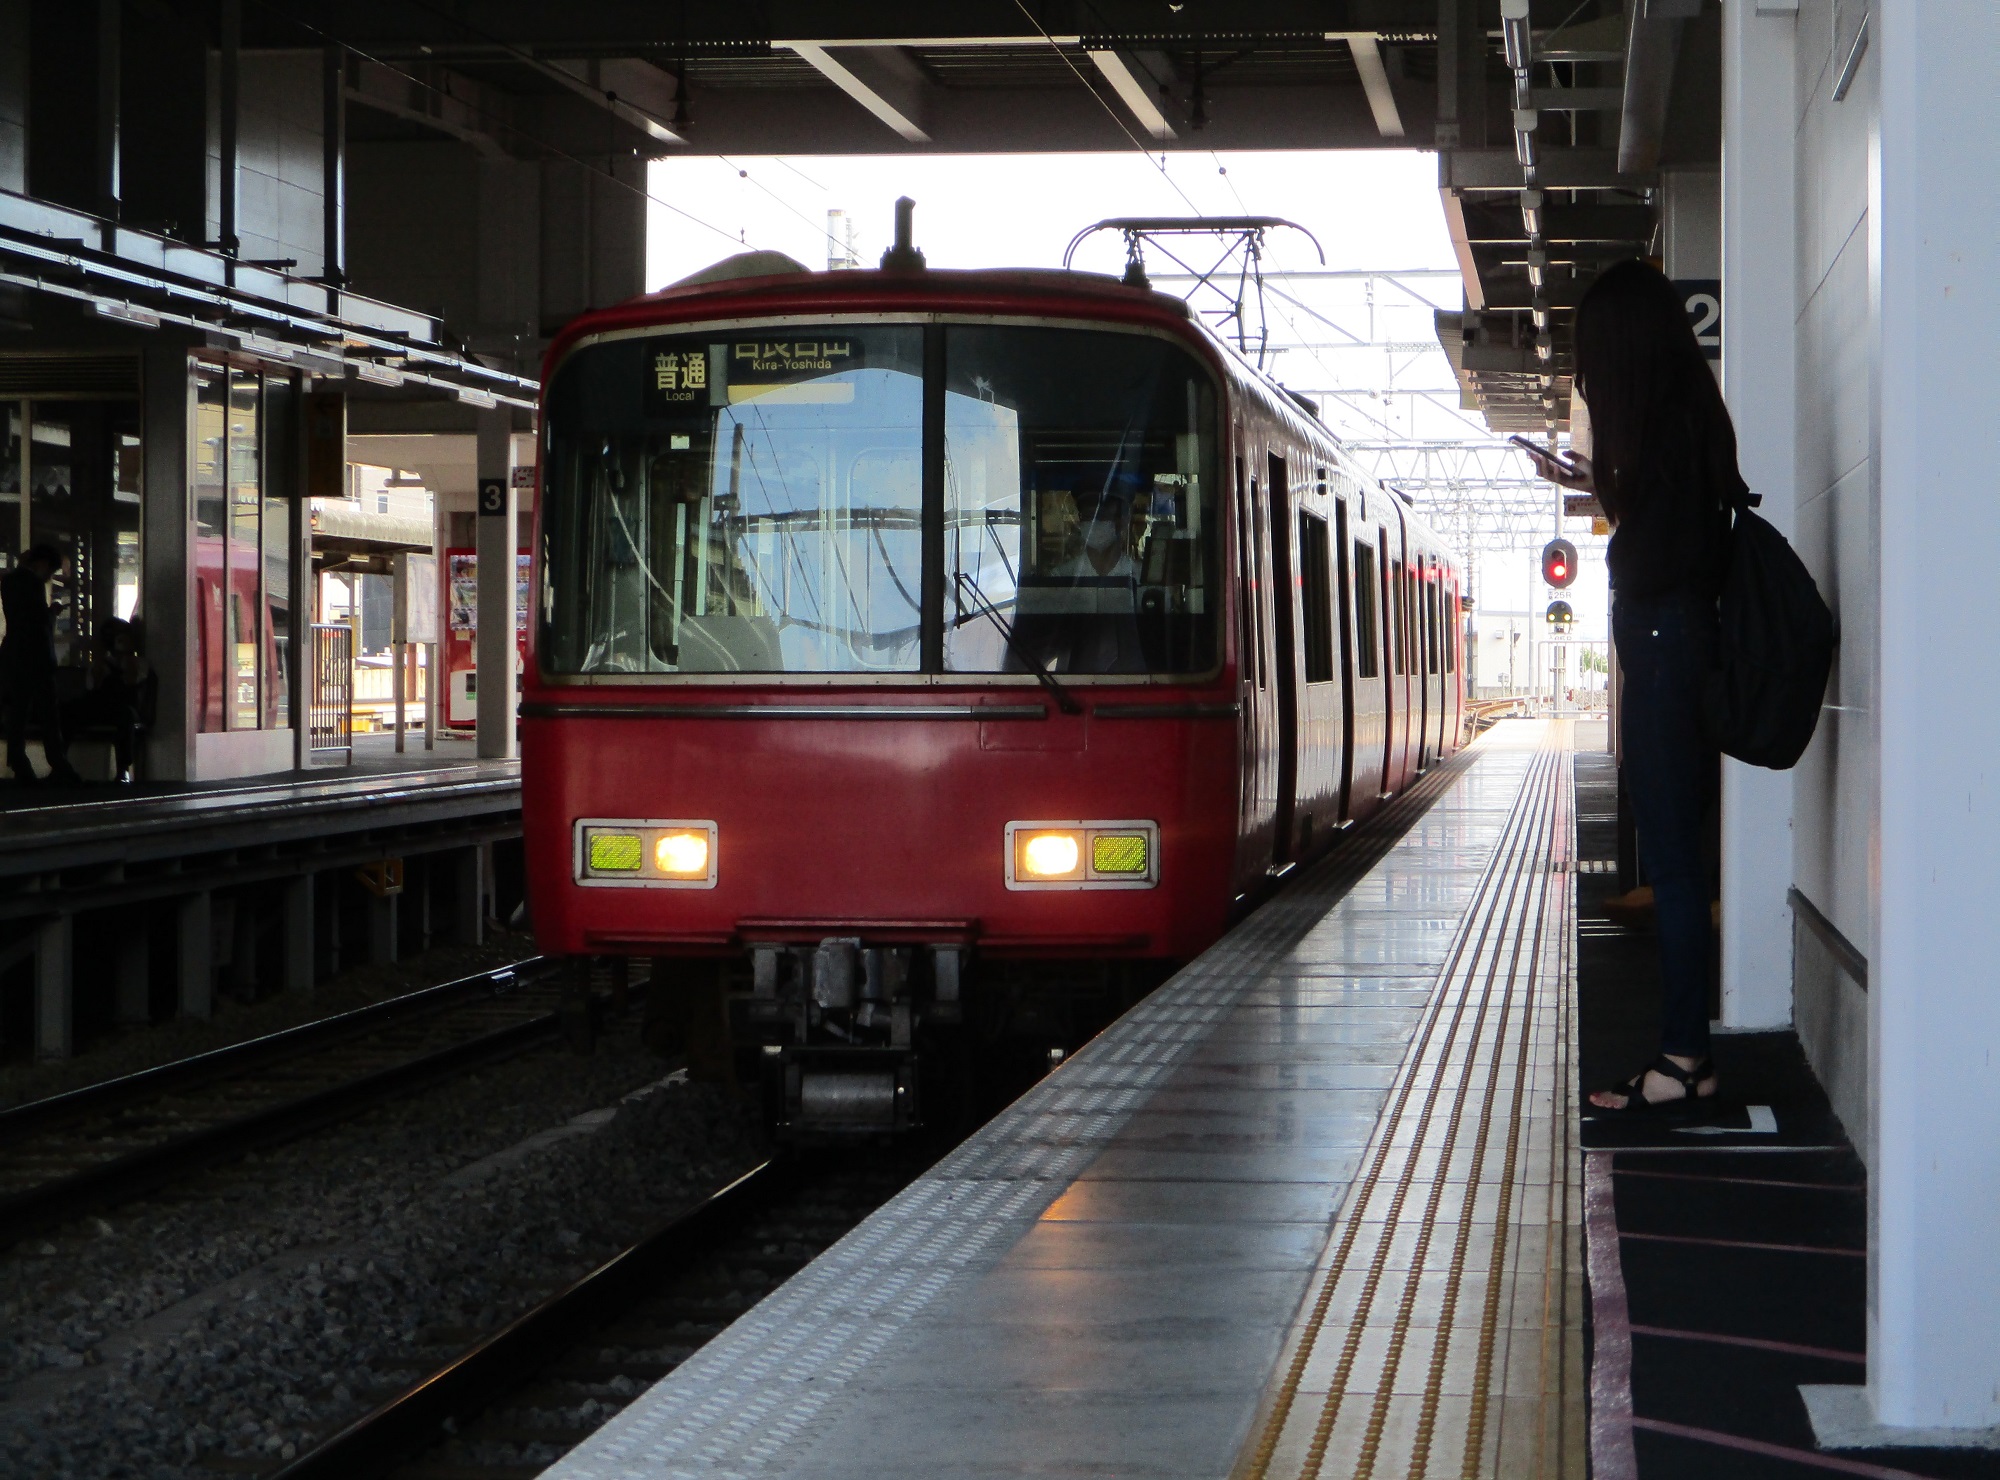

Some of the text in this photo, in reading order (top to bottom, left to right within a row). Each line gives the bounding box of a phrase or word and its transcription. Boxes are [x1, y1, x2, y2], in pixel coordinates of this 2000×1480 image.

[1684, 293, 1720, 346] 2
[654, 352, 706, 390] 普通
[752, 358, 832, 371] Kira-Yoshida
[665, 391, 695, 401] Local
[484, 484, 501, 511] 3
